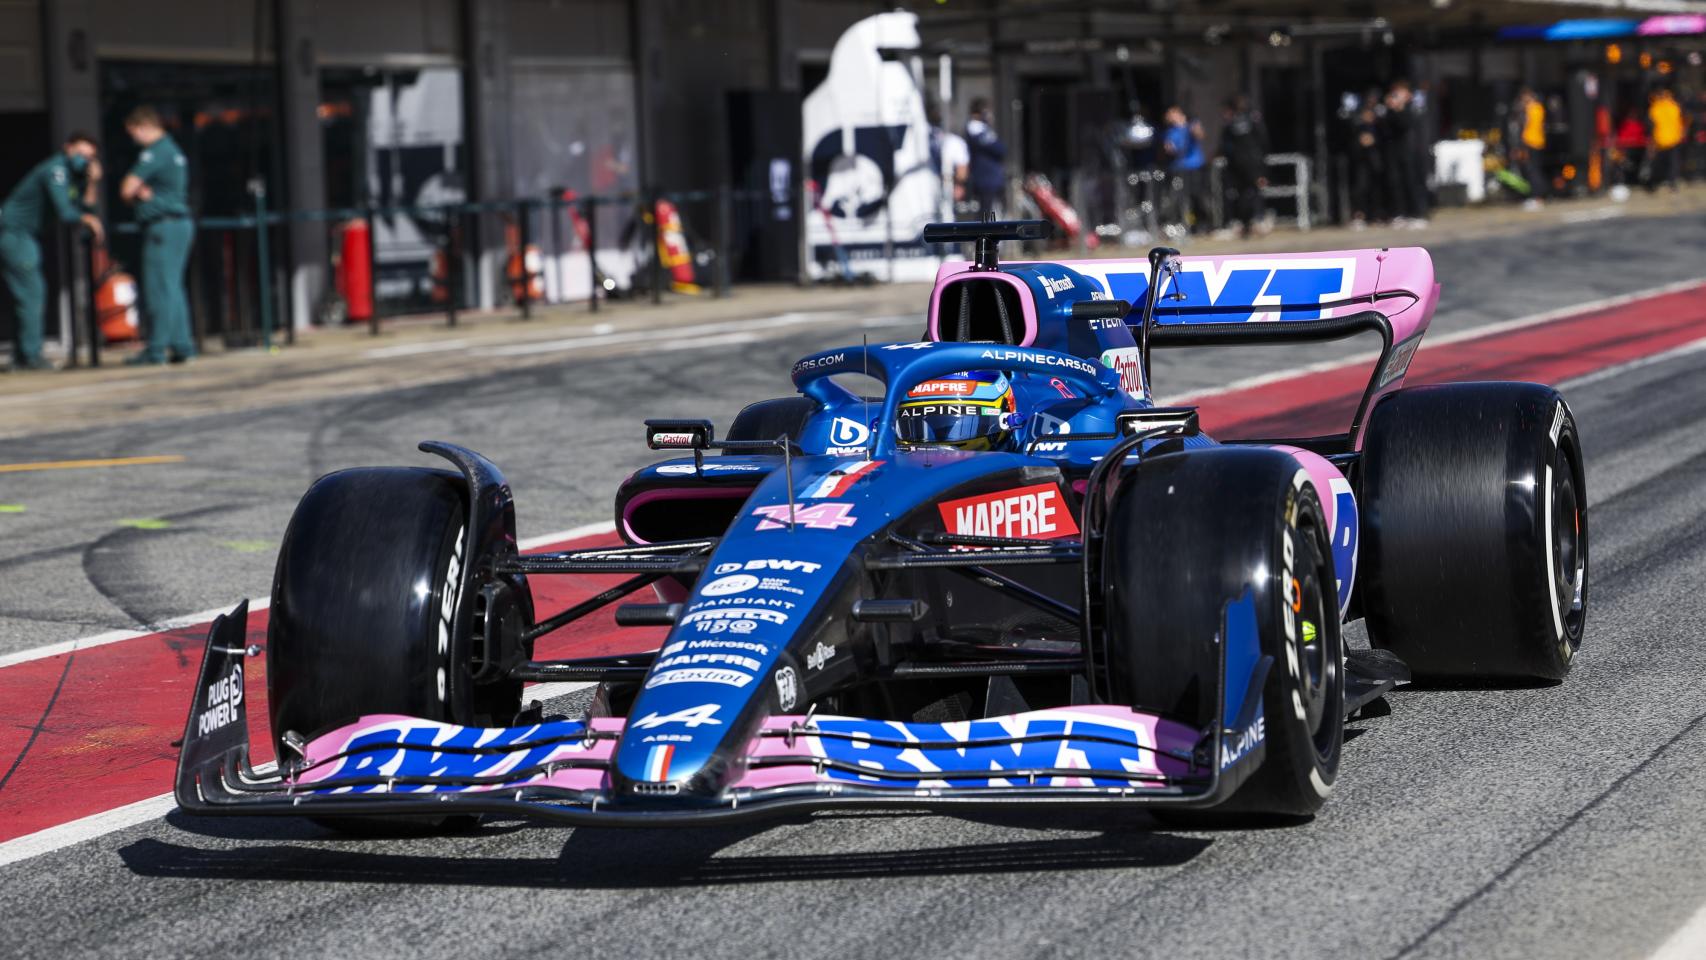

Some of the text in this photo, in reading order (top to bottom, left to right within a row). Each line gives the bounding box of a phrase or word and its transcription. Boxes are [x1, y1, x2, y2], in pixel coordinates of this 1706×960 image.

[981, 350, 1097, 377] ALPINECARS.COM
[911, 381, 969, 394] MAPFRE
[900, 405, 978, 419] ALPINE
[956, 490, 1057, 539] MAPFRE
[743, 559, 822, 574] BWT
[689, 597, 795, 612] MANDIANT
[688, 639, 769, 655] Microsoft
[653, 653, 762, 672] MAPFRE
[208, 677, 230, 708] PLUG
[198, 702, 230, 737] POWER
[1221, 716, 1265, 769] ALPINE
